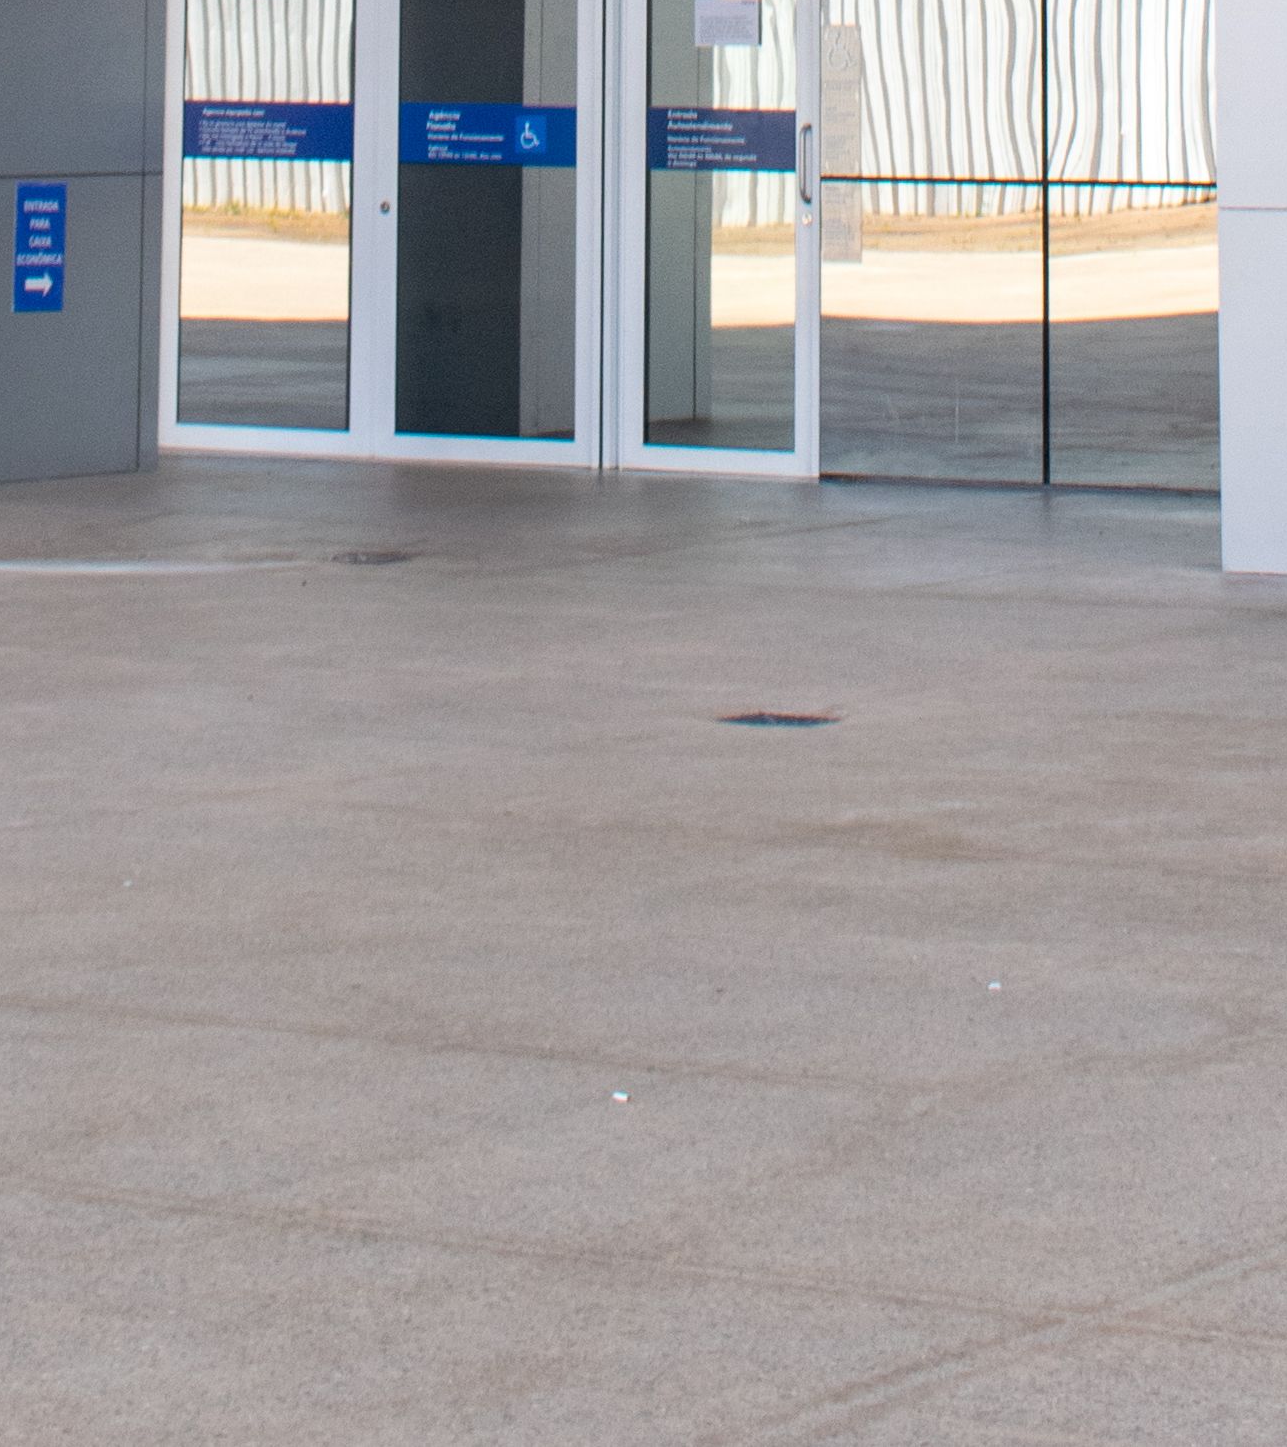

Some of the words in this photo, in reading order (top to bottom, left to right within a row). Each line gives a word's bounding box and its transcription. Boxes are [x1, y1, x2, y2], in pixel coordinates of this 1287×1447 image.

[23, 200, 59, 213] ENTRADA
[29, 218, 51, 230] PARA
[28, 235, 52, 249] CAIXA
